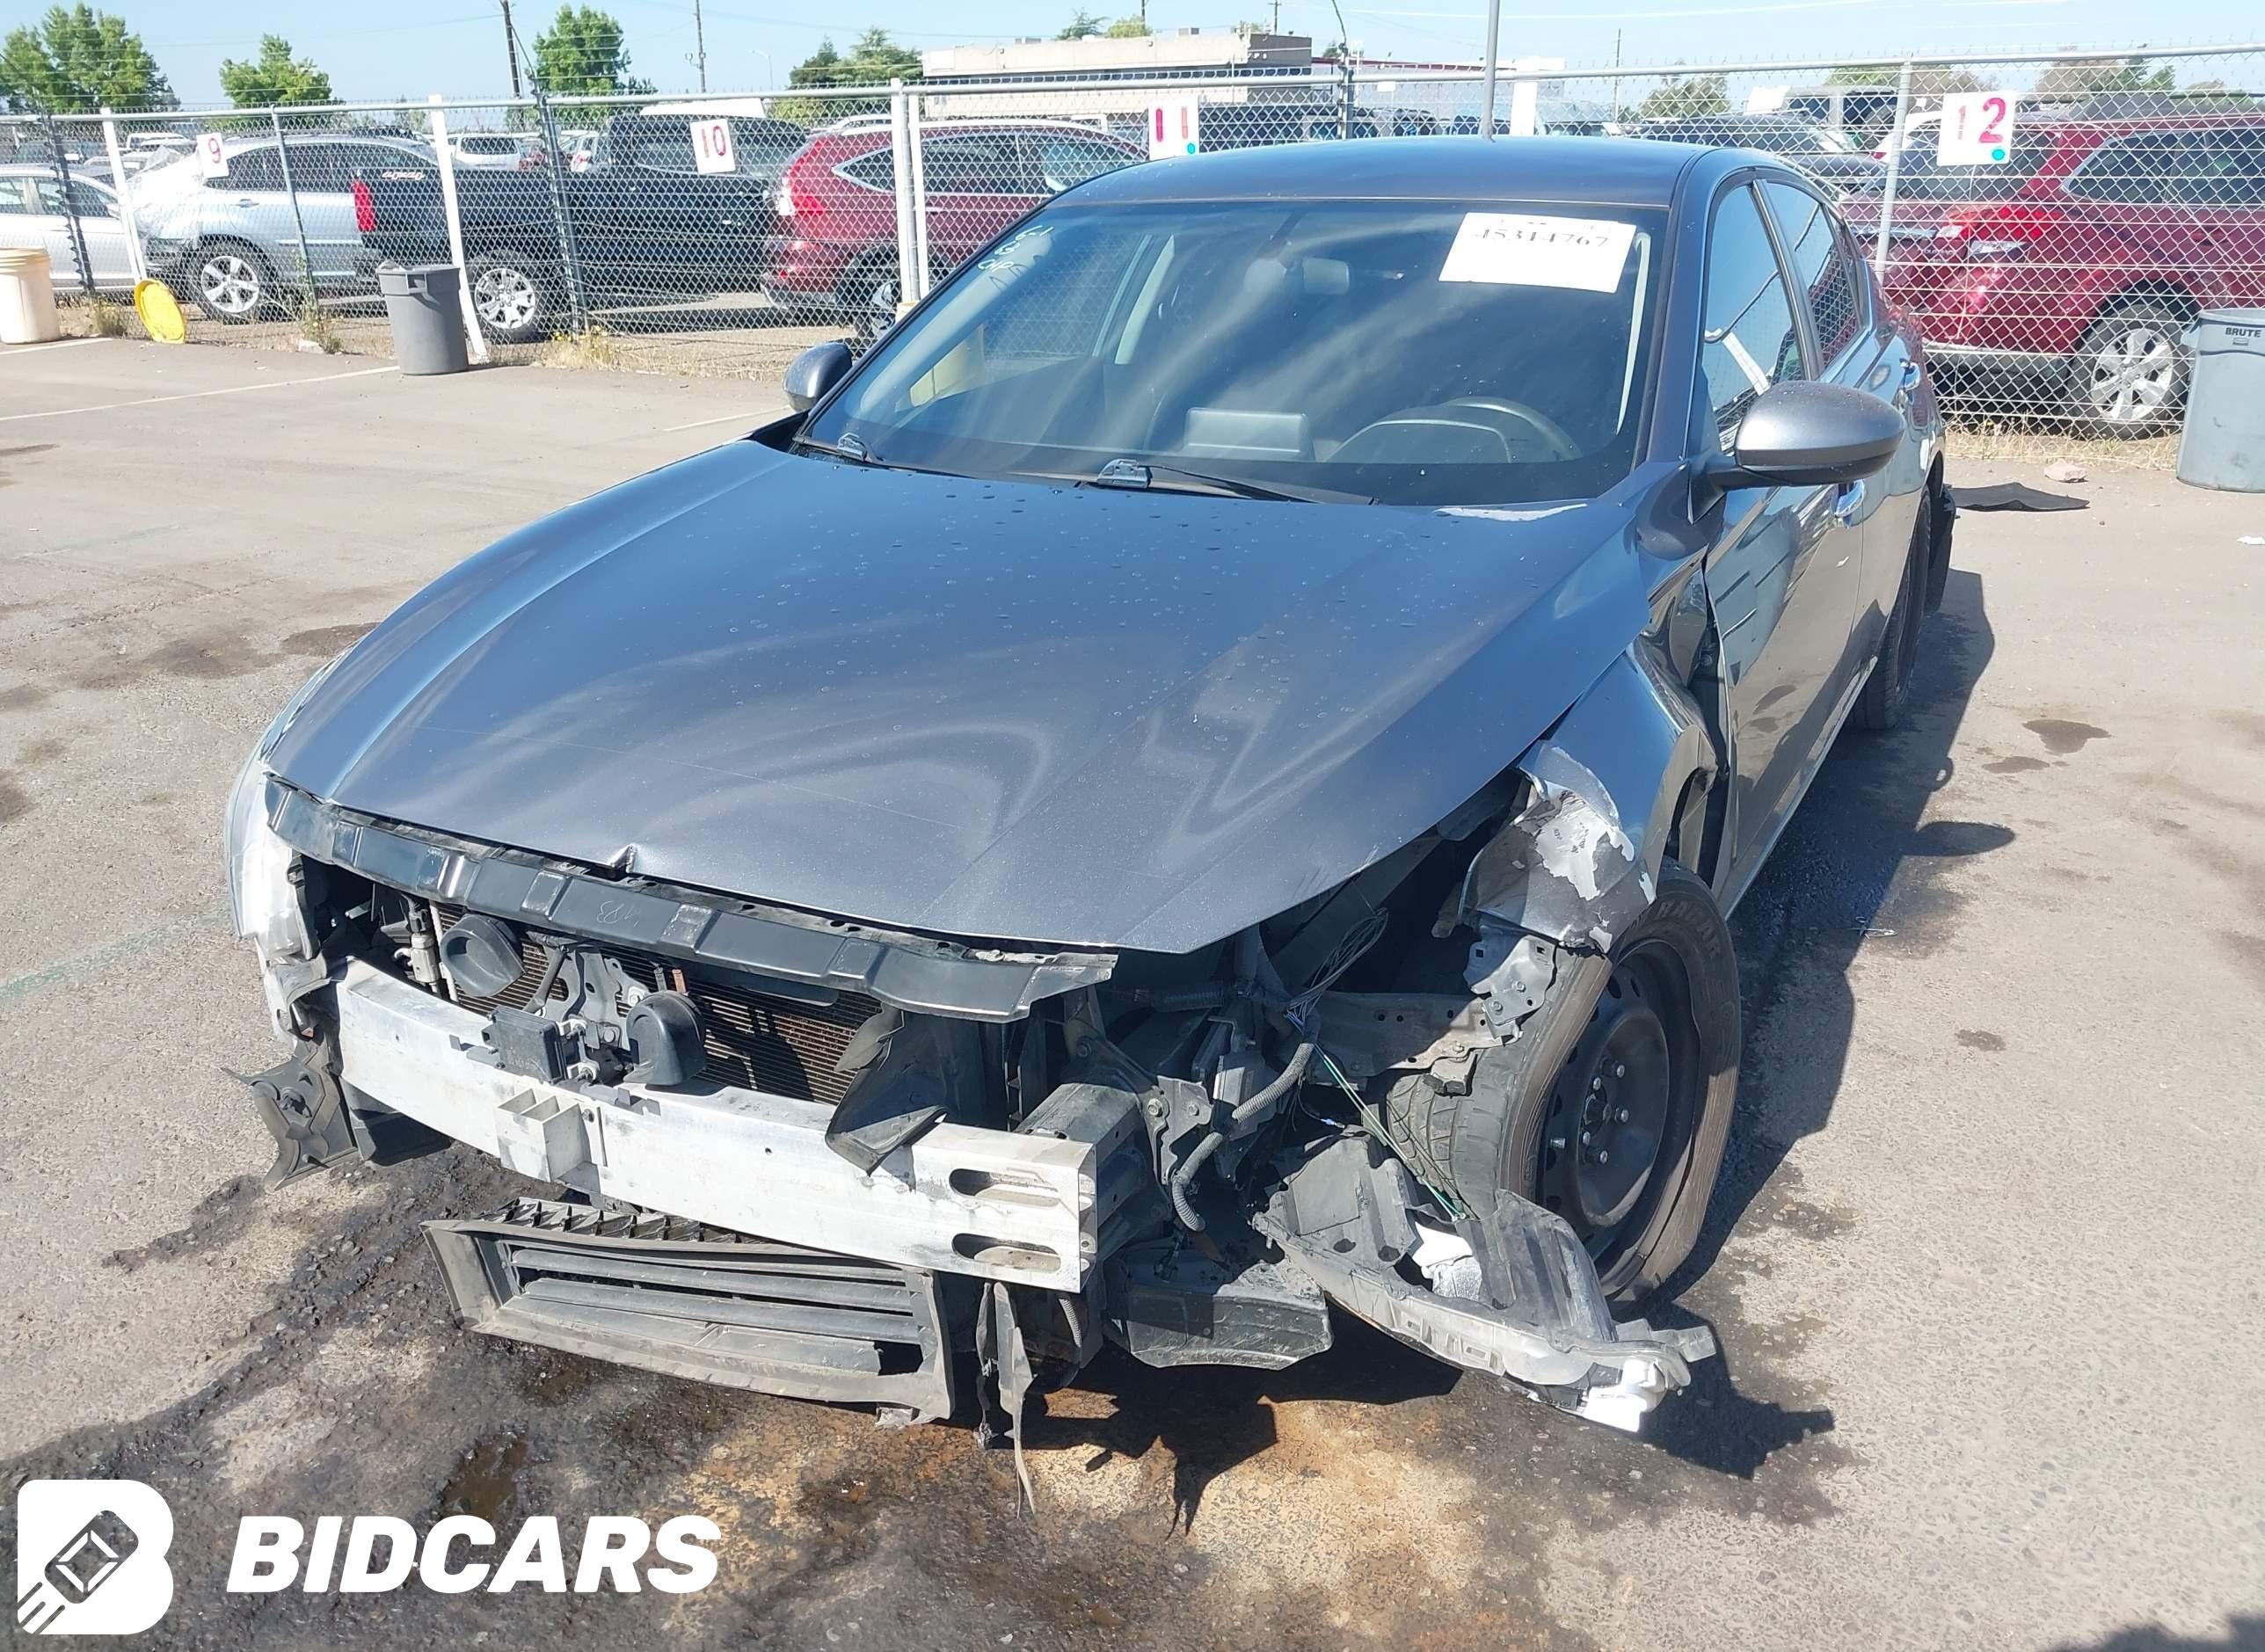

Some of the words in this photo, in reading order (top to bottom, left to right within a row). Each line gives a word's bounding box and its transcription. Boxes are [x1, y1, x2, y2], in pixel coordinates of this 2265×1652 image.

[1957, 97, 2006, 143] 12
[208, 137, 222, 164] 9
[701, 125, 726, 158] 10
[2225, 326, 2262, 338] BRUTE
